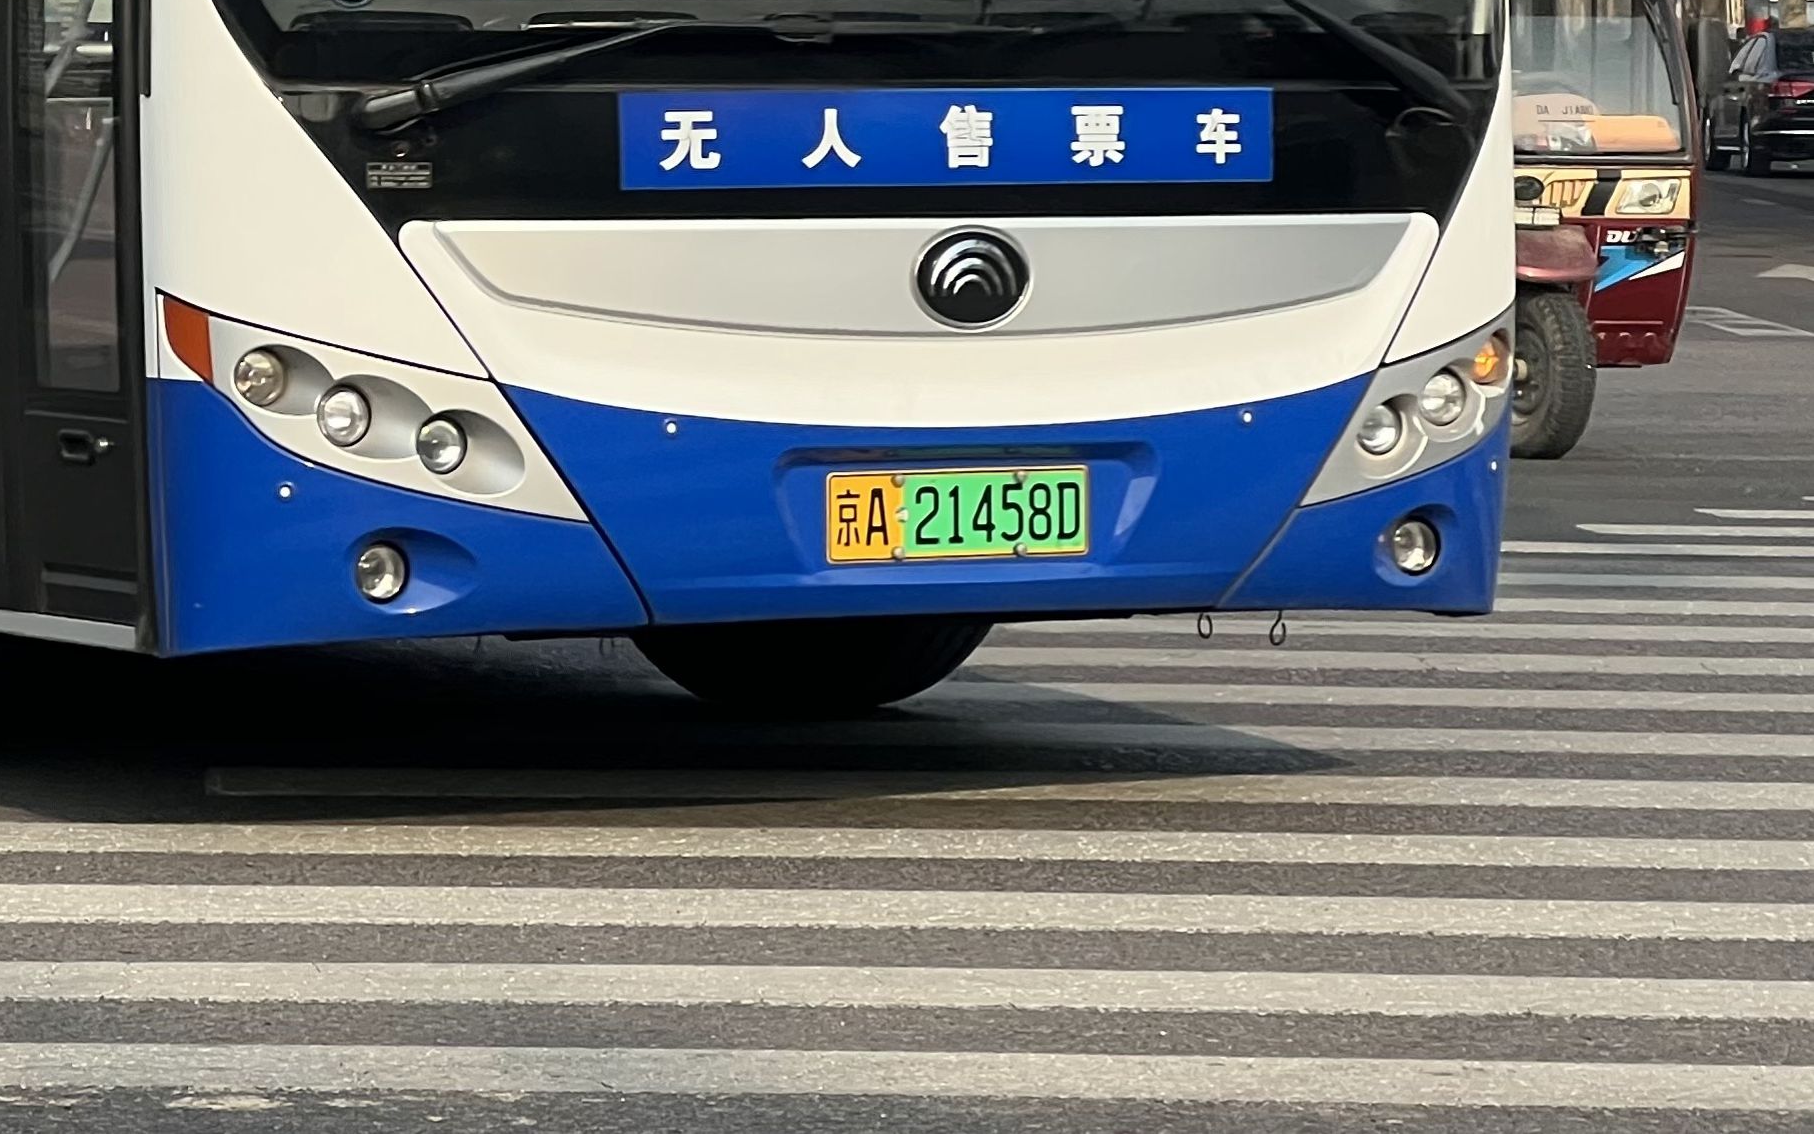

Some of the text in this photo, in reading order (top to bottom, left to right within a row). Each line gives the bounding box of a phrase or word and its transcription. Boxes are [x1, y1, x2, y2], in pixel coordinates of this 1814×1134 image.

[659, 104, 1243, 171] 无人售票车
